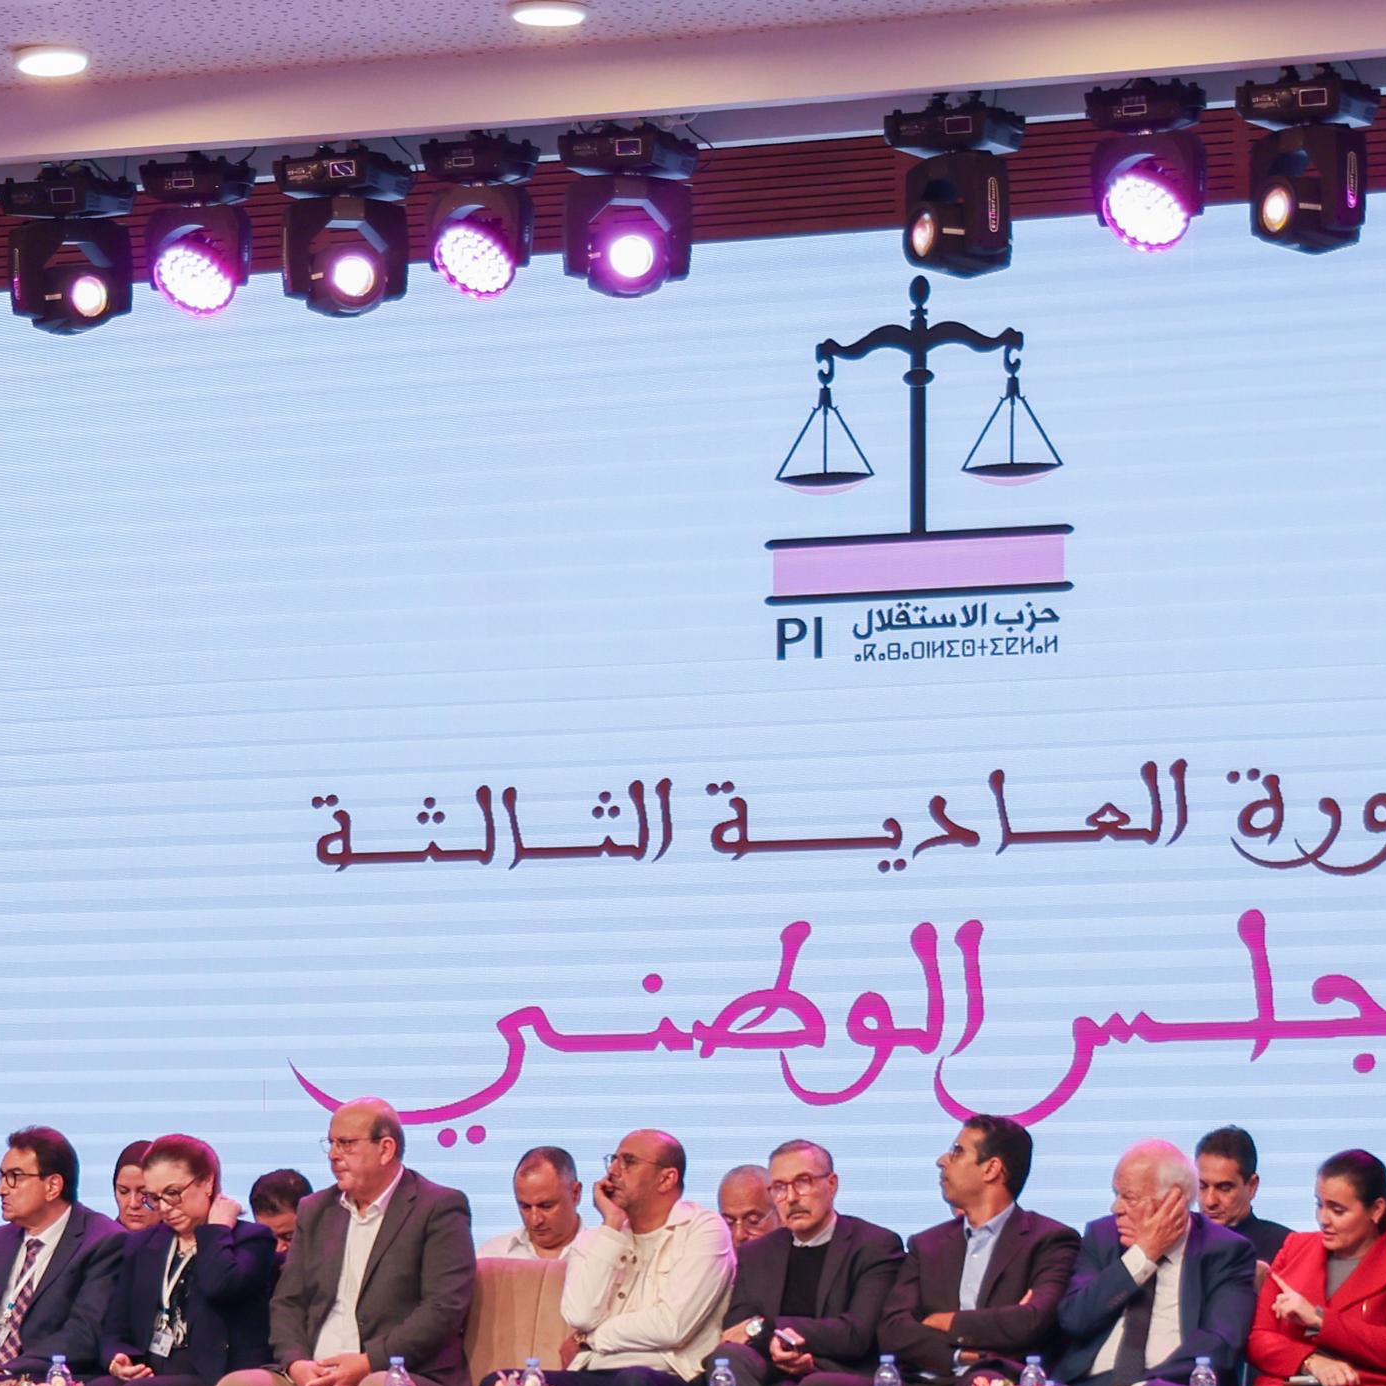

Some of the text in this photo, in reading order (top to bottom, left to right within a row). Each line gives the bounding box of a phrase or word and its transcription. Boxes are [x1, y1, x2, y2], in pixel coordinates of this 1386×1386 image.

[776, 616, 823, 661] PI
[853, 601, 1060, 640] حزب الاستقلال
[312, 778, 672, 871] الثالثة
[706, 759, 1187, 872] العادية
[289, 920, 984, 1147] الوطني
